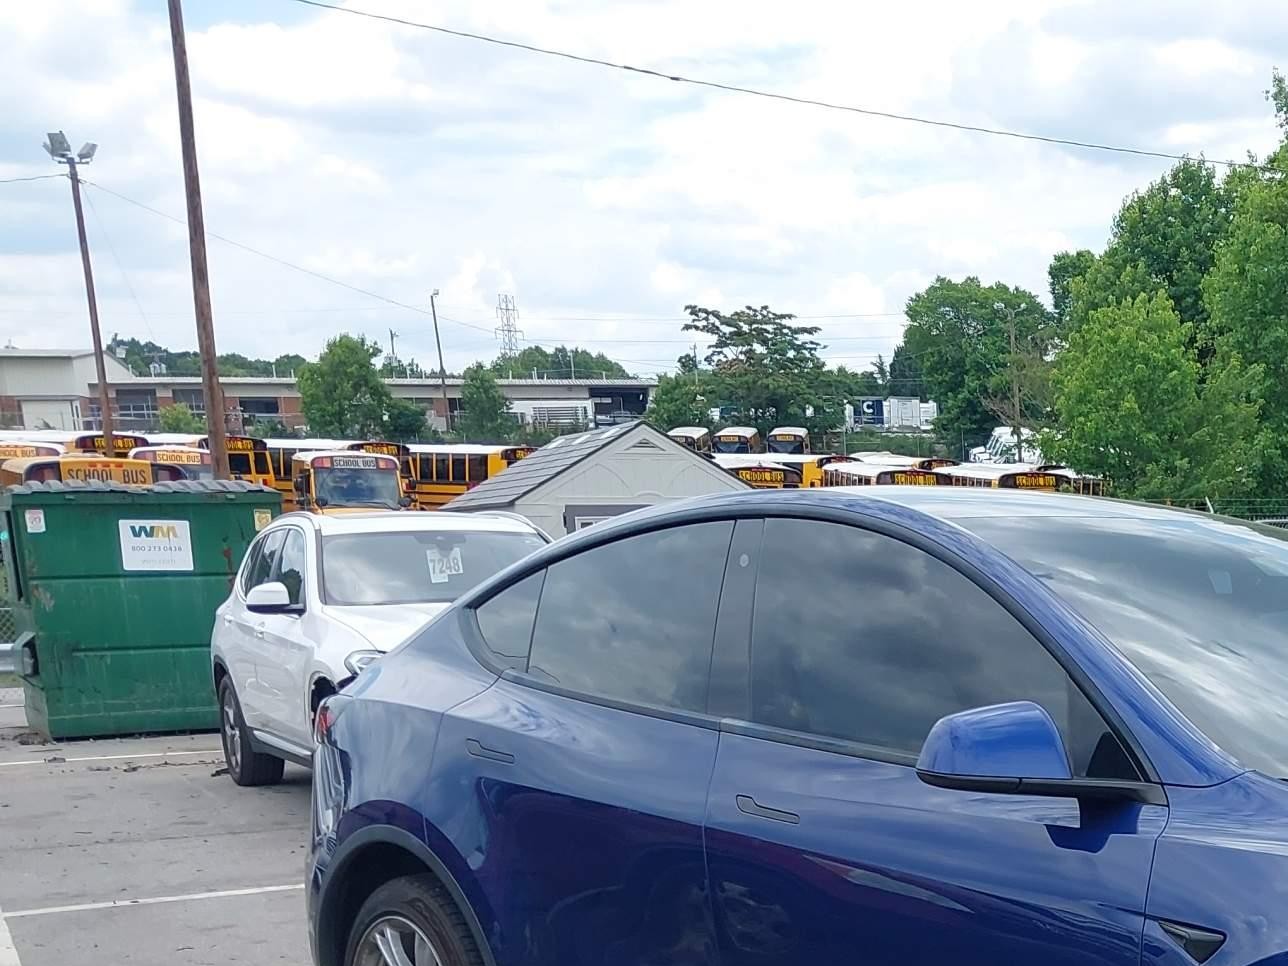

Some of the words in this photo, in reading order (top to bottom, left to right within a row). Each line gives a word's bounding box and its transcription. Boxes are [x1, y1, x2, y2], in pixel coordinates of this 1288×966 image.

[157, 455, 185, 463] SCHOOL
[186, 456, 200, 464] BUS
[335, 458, 360, 467] SCHOOL
[362, 459, 376, 467] BUS
[67, 469, 113, 482] SCHOOL
[123, 470, 146, 484] BUS
[740, 471, 767, 482] SCHOOL
[769, 472, 784, 482] BUS
[895, 474, 921, 485] SCHOOL
[130, 525, 178, 538] WM
[430, 557, 460, 575] 7248
